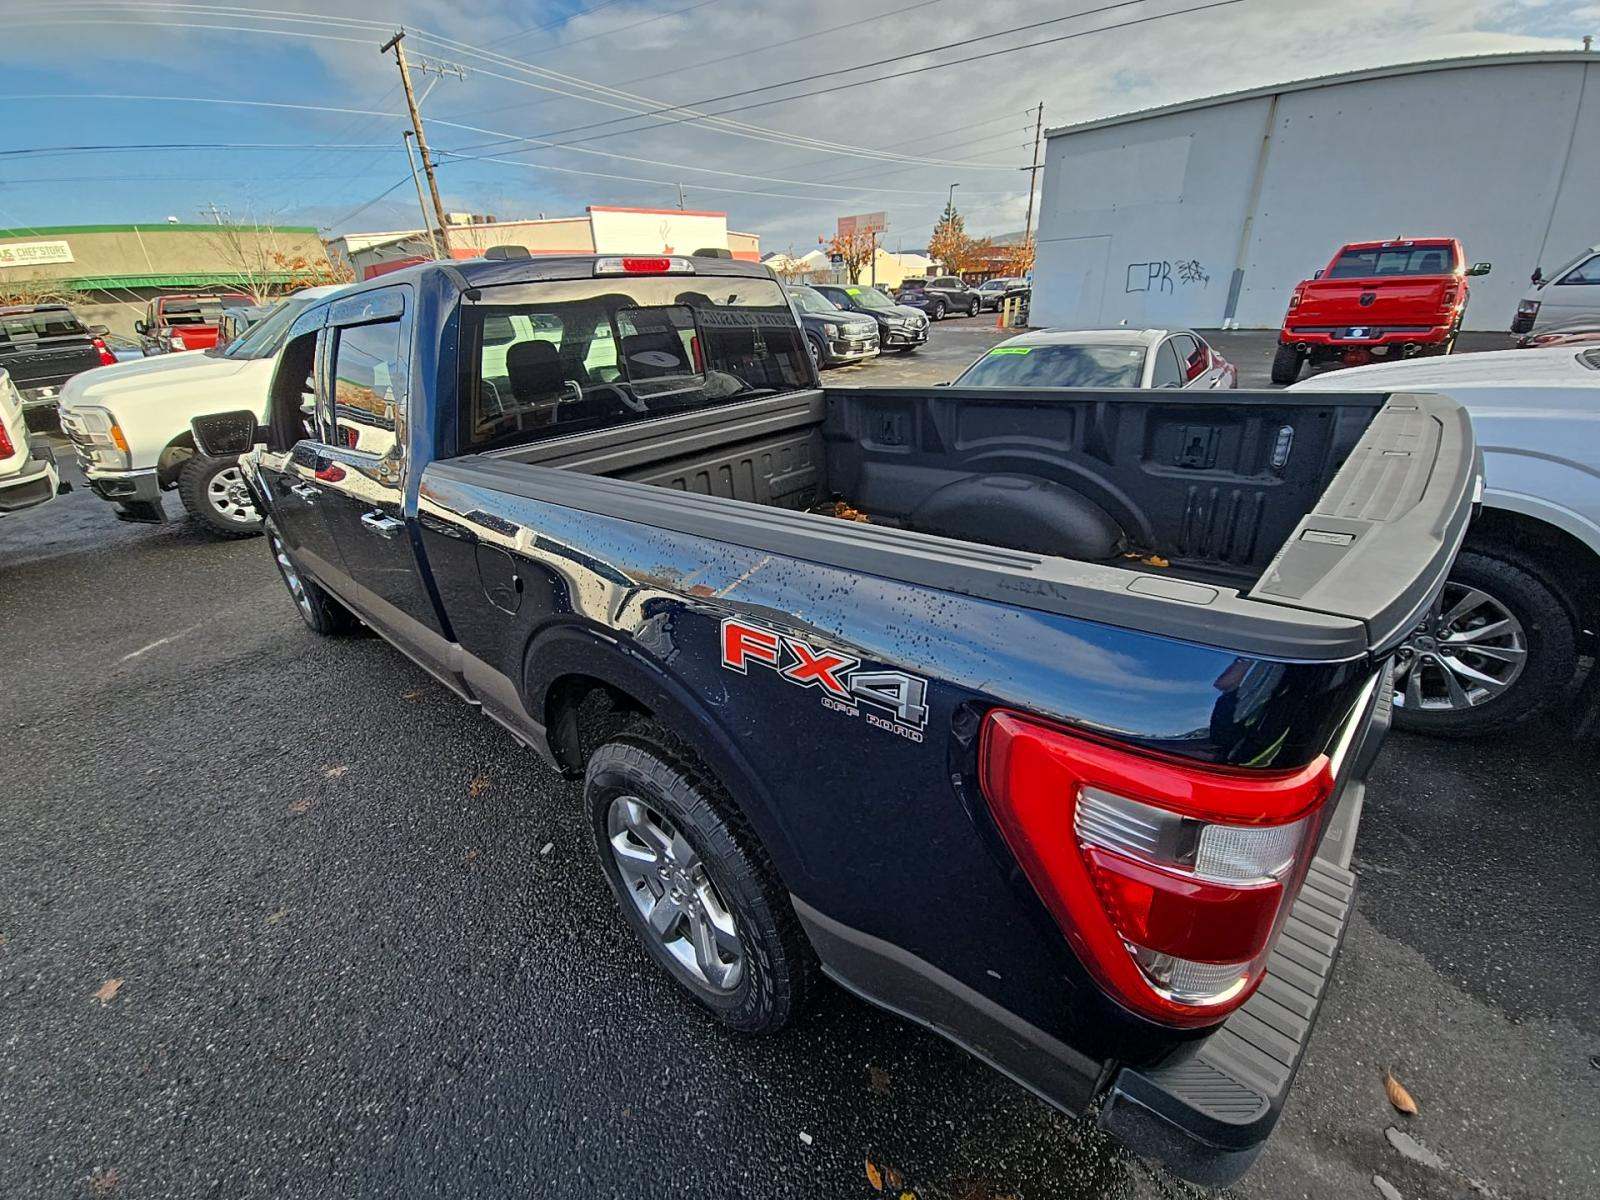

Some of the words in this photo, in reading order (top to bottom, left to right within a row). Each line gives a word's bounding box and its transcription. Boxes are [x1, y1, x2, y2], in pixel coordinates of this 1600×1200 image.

[1125, 261, 1174, 295] CPR
[721, 616, 929, 731] FX4
[820, 696, 860, 718] OFF
[866, 713, 924, 743] ROAD
